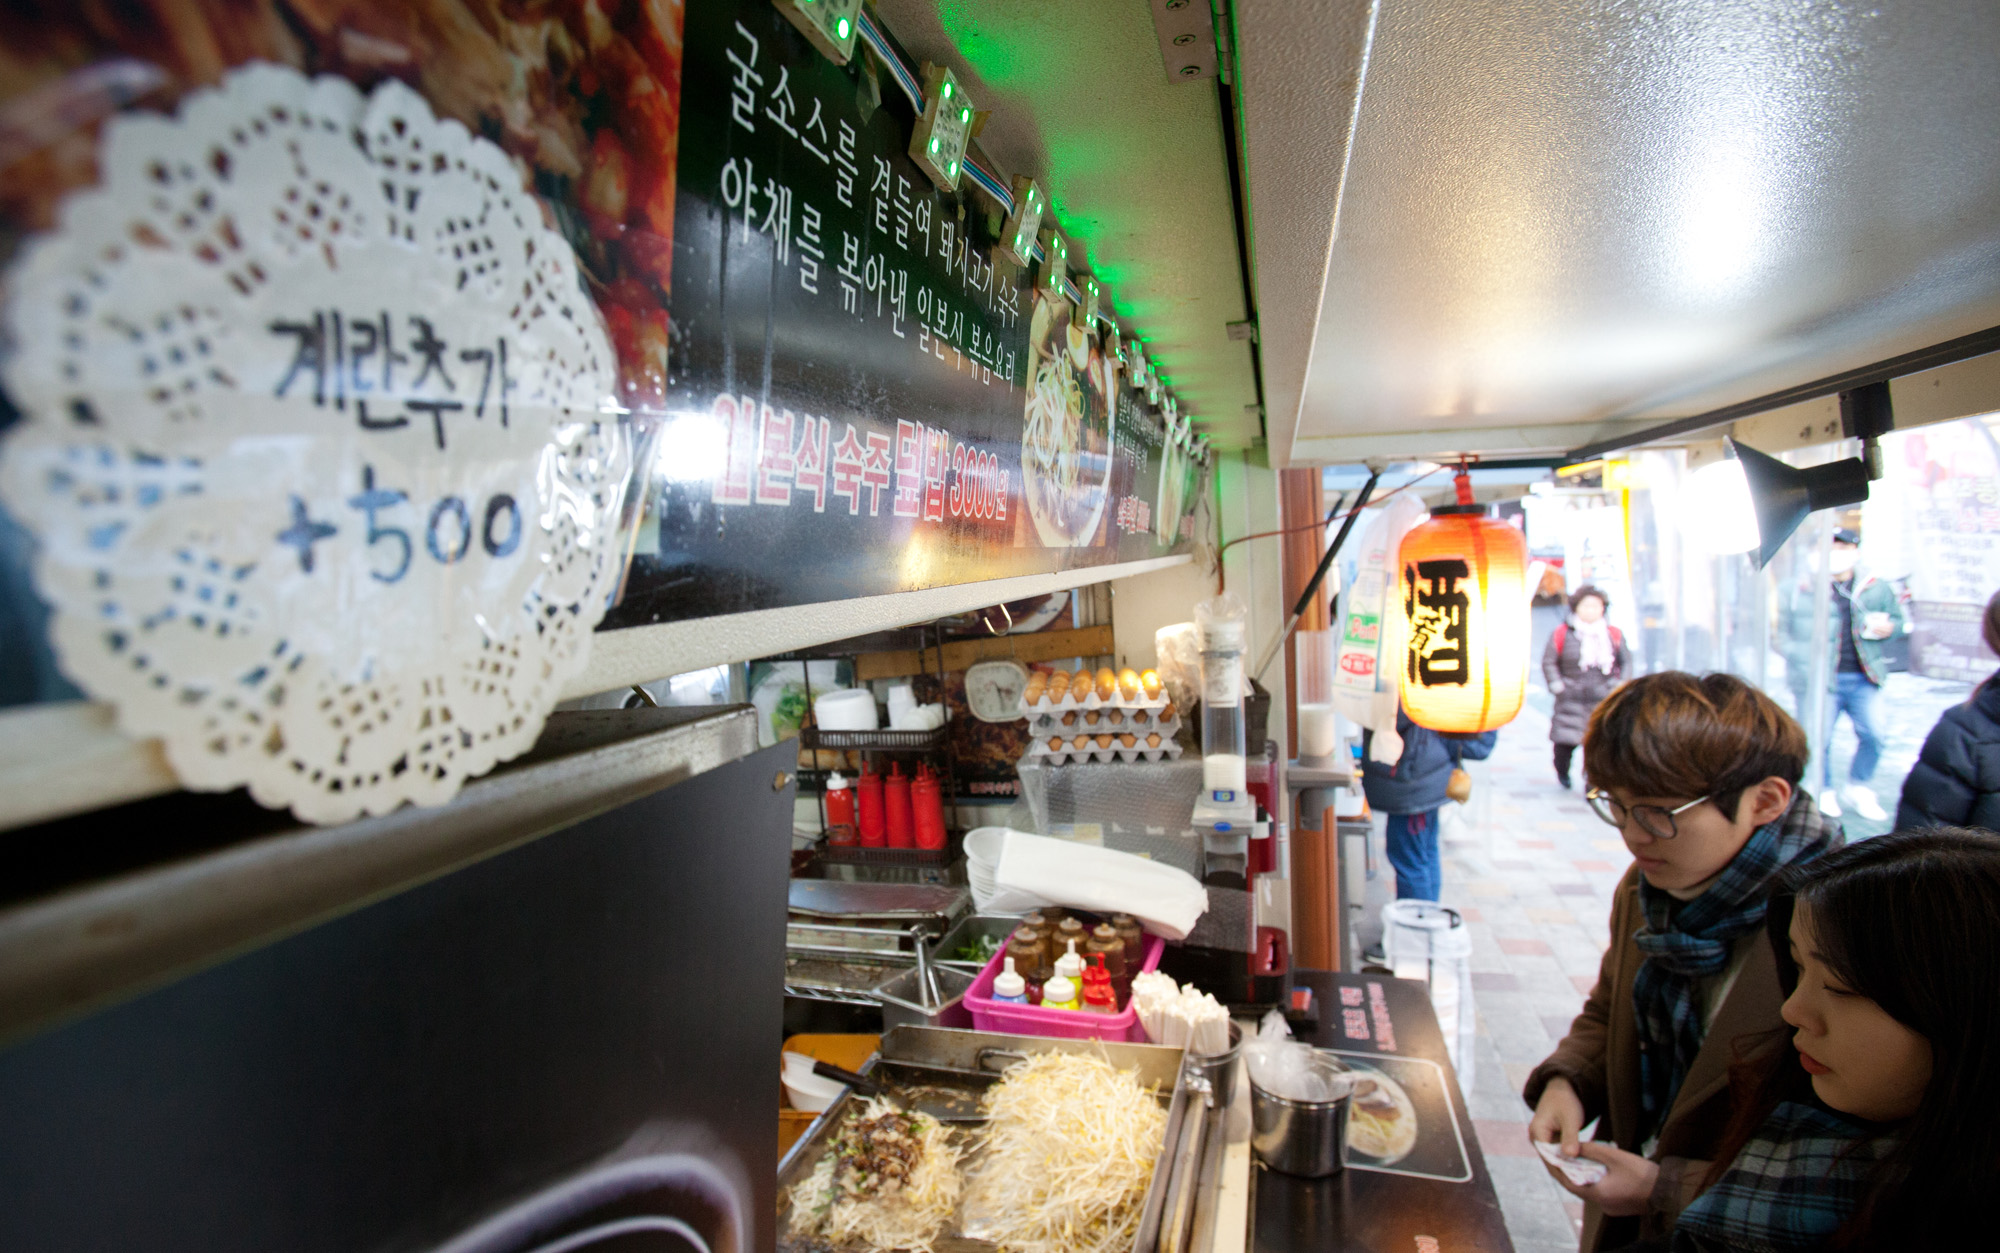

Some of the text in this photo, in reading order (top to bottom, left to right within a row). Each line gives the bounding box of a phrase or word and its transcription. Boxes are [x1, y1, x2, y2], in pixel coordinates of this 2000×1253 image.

[726, 20, 859, 208] 굴소스를
[871, 154, 932, 257] 곁들여
[720, 157, 1016, 392] 야채를 볶아낸 일본식 볶음요리
[268, 311, 517, 450] 계란추가
[276, 464, 524, 584] +500
[950, 442, 1010, 521] 3000원
